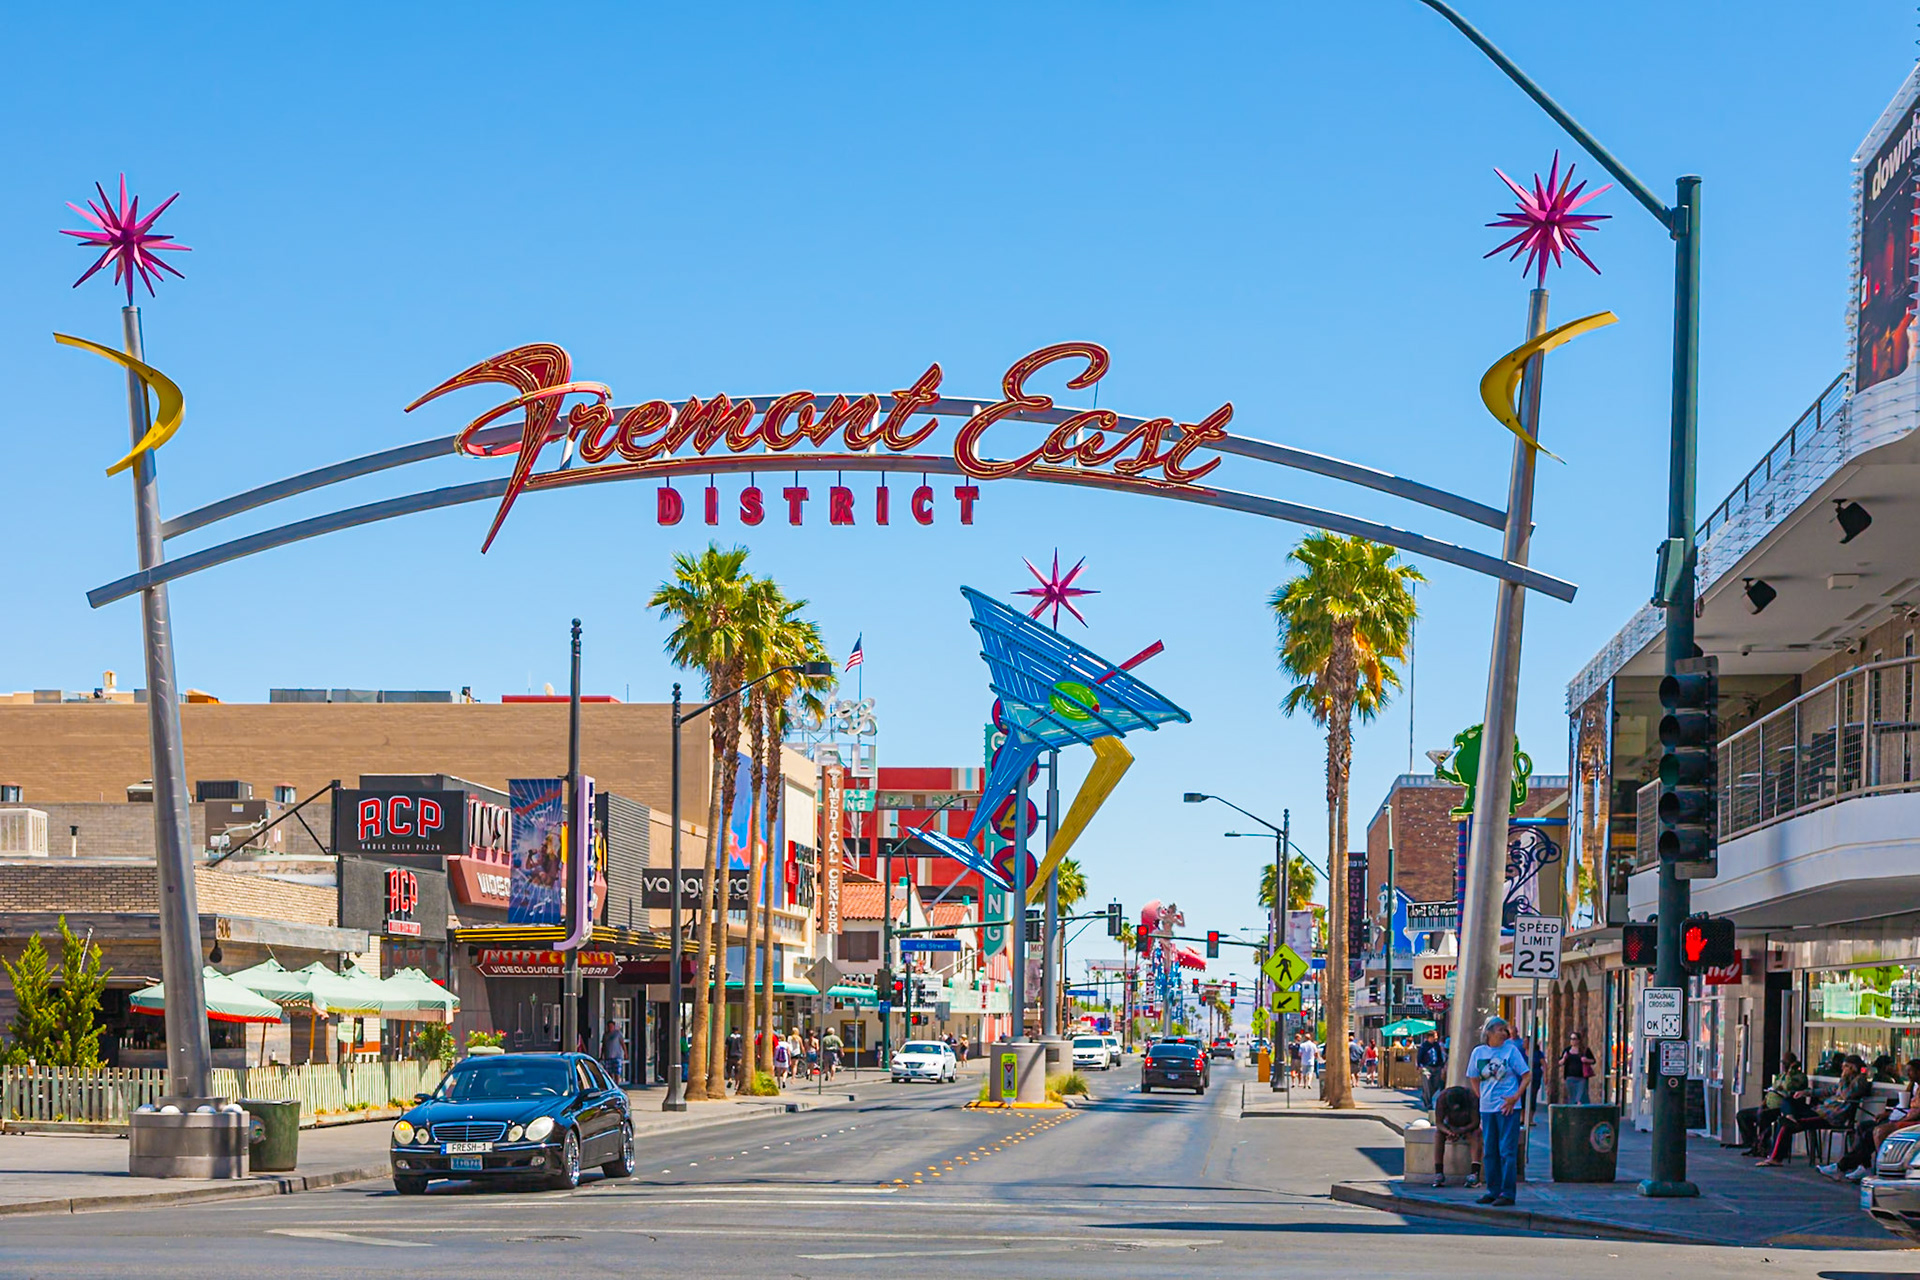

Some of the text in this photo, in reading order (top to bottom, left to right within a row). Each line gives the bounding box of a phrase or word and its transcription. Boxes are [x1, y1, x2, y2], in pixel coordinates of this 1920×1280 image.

[405, 341, 1235, 554] Fremont East
[657, 486, 980, 526] DISTRICT
[358, 795, 443, 841] RCP
[391, 843, 411, 851] CITY
[828, 787, 841, 934] MEDICAL CENTER
[389, 868, 419, 915] RCP
[217, 918, 231, 938] 506
[1518, 922, 1560, 934] SPEED
[1522, 935, 1554, 947] LIMIT
[490, 965, 559, 974] VIDEOLOUNGE
[1518, 950, 1556, 974] 25
[1649, 992, 1675, 1000] DIAGONAL
[1647, 1021, 1659, 1030] OK
[452, 1143, 487, 1152] FRESH-1
